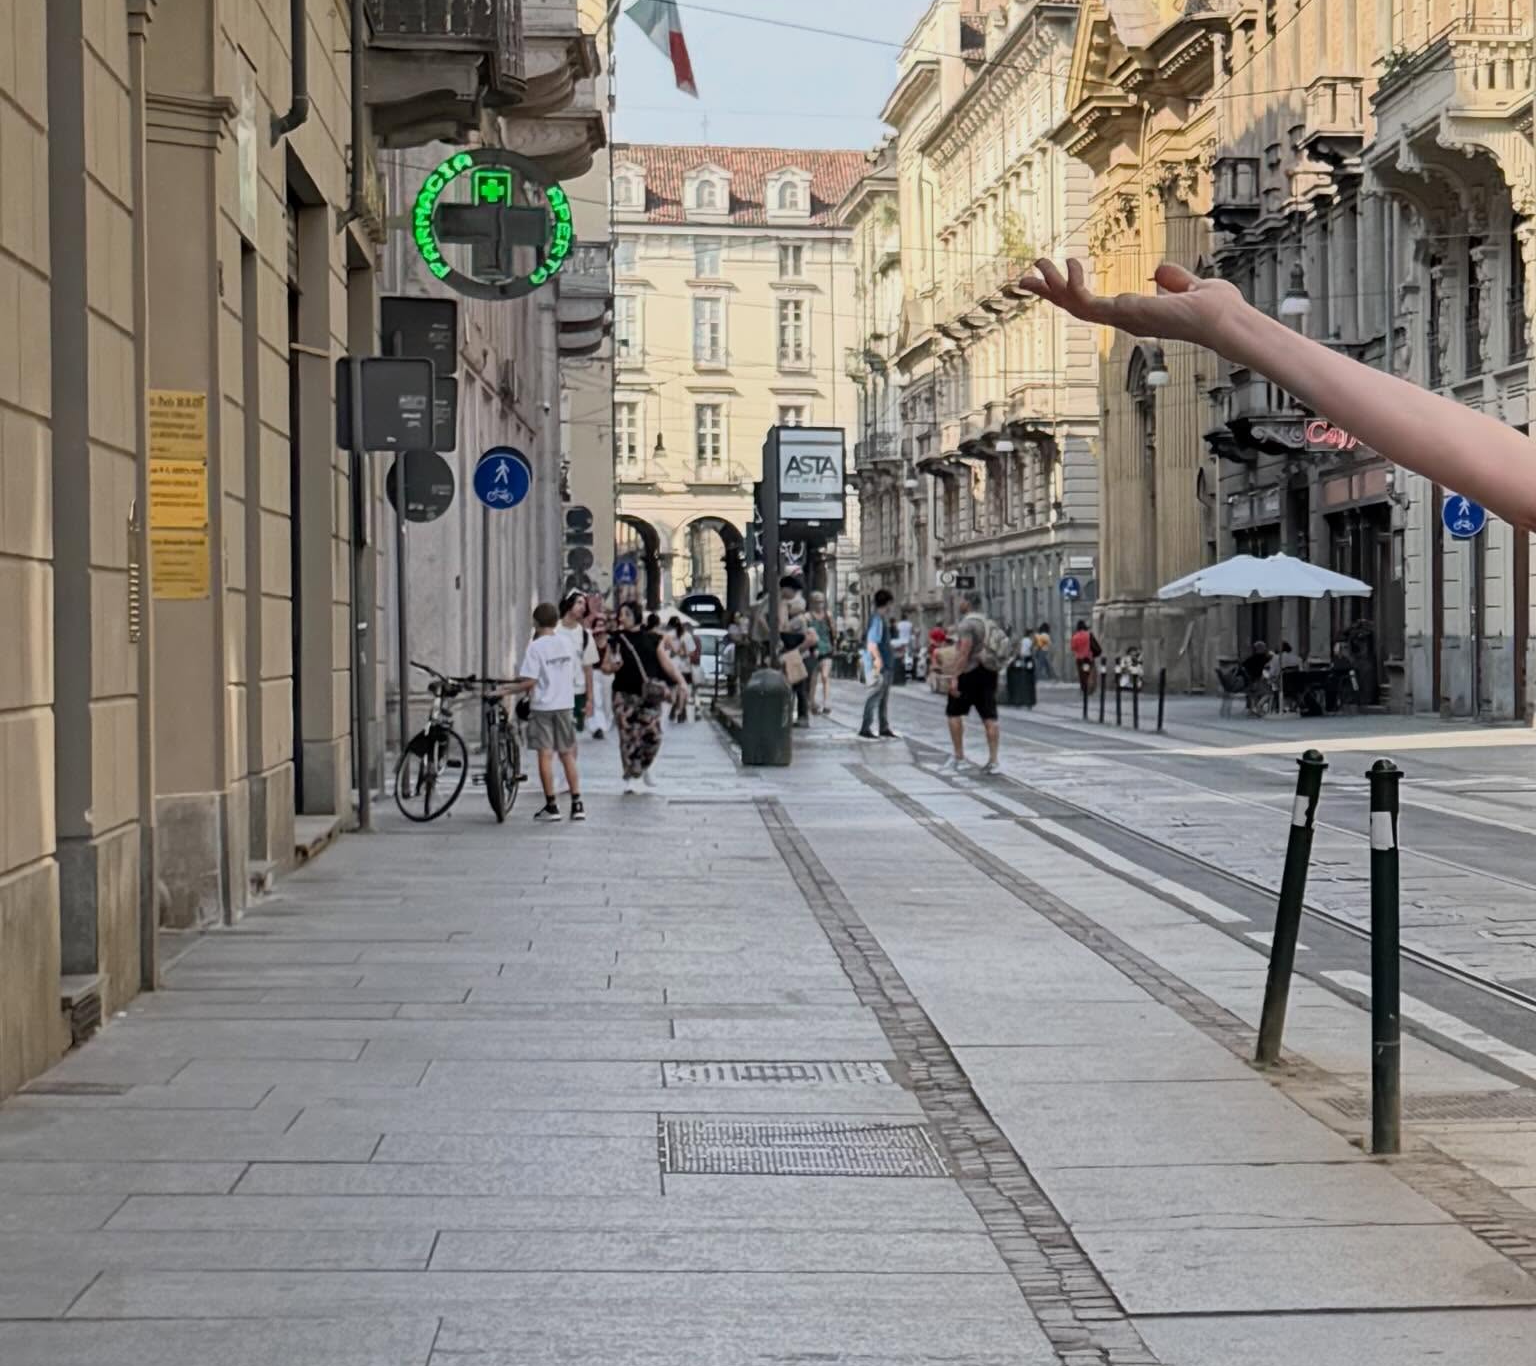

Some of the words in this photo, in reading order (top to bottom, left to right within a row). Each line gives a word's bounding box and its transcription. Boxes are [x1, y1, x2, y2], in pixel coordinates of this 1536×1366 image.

[415, 153, 473, 278] FARMACIA
[529, 186, 571, 284] APERTA
[784, 455, 839, 475] ASTA
